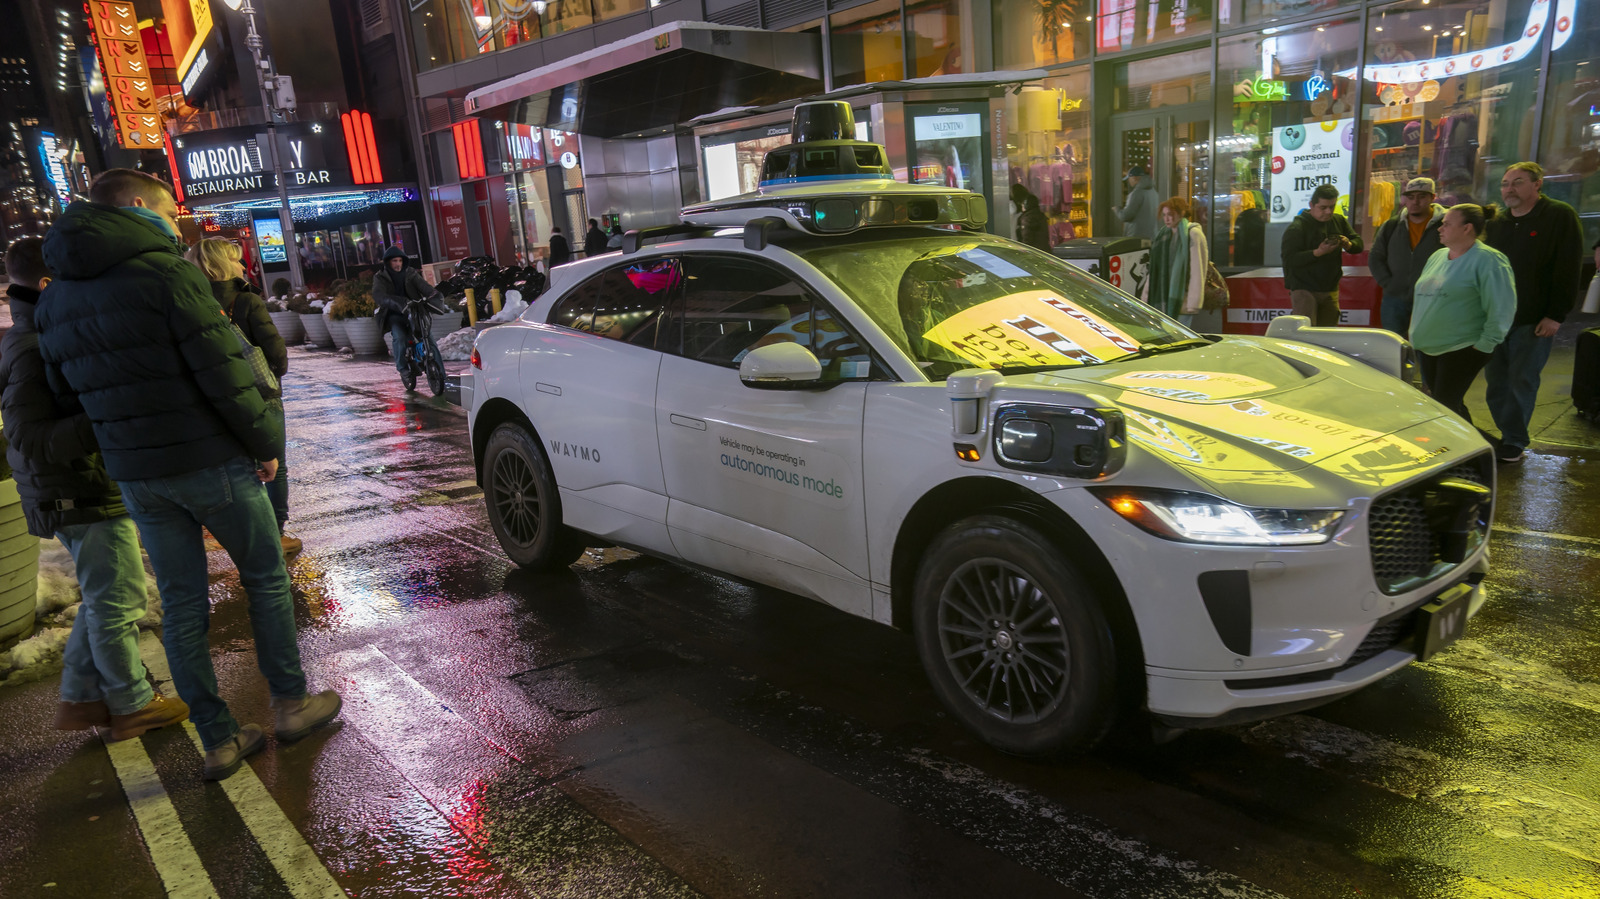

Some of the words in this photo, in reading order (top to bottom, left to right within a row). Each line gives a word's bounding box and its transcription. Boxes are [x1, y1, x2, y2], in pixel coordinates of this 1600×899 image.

[99, 2, 140, 130] JUNIORS
[932, 121, 964, 132] VALENTINO
[208, 141, 303, 177] BROAY
[1293, 150, 1340, 163] personal
[1312, 143, 1322, 152] get
[1302, 162, 1317, 171] with
[1316, 162, 1331, 171] your
[187, 175, 263, 197] RESTAURANT
[296, 170, 330, 185] BAR
[550, 440, 600, 463] WAYMO
[719, 436, 741, 450] Vehicle
[742, 443, 755, 455] may
[756, 445, 764, 455] be
[765, 450, 798, 467] operating
[798, 456, 806, 466] in
[720, 453, 800, 486] autonomous
[803, 476, 843, 498] mode
